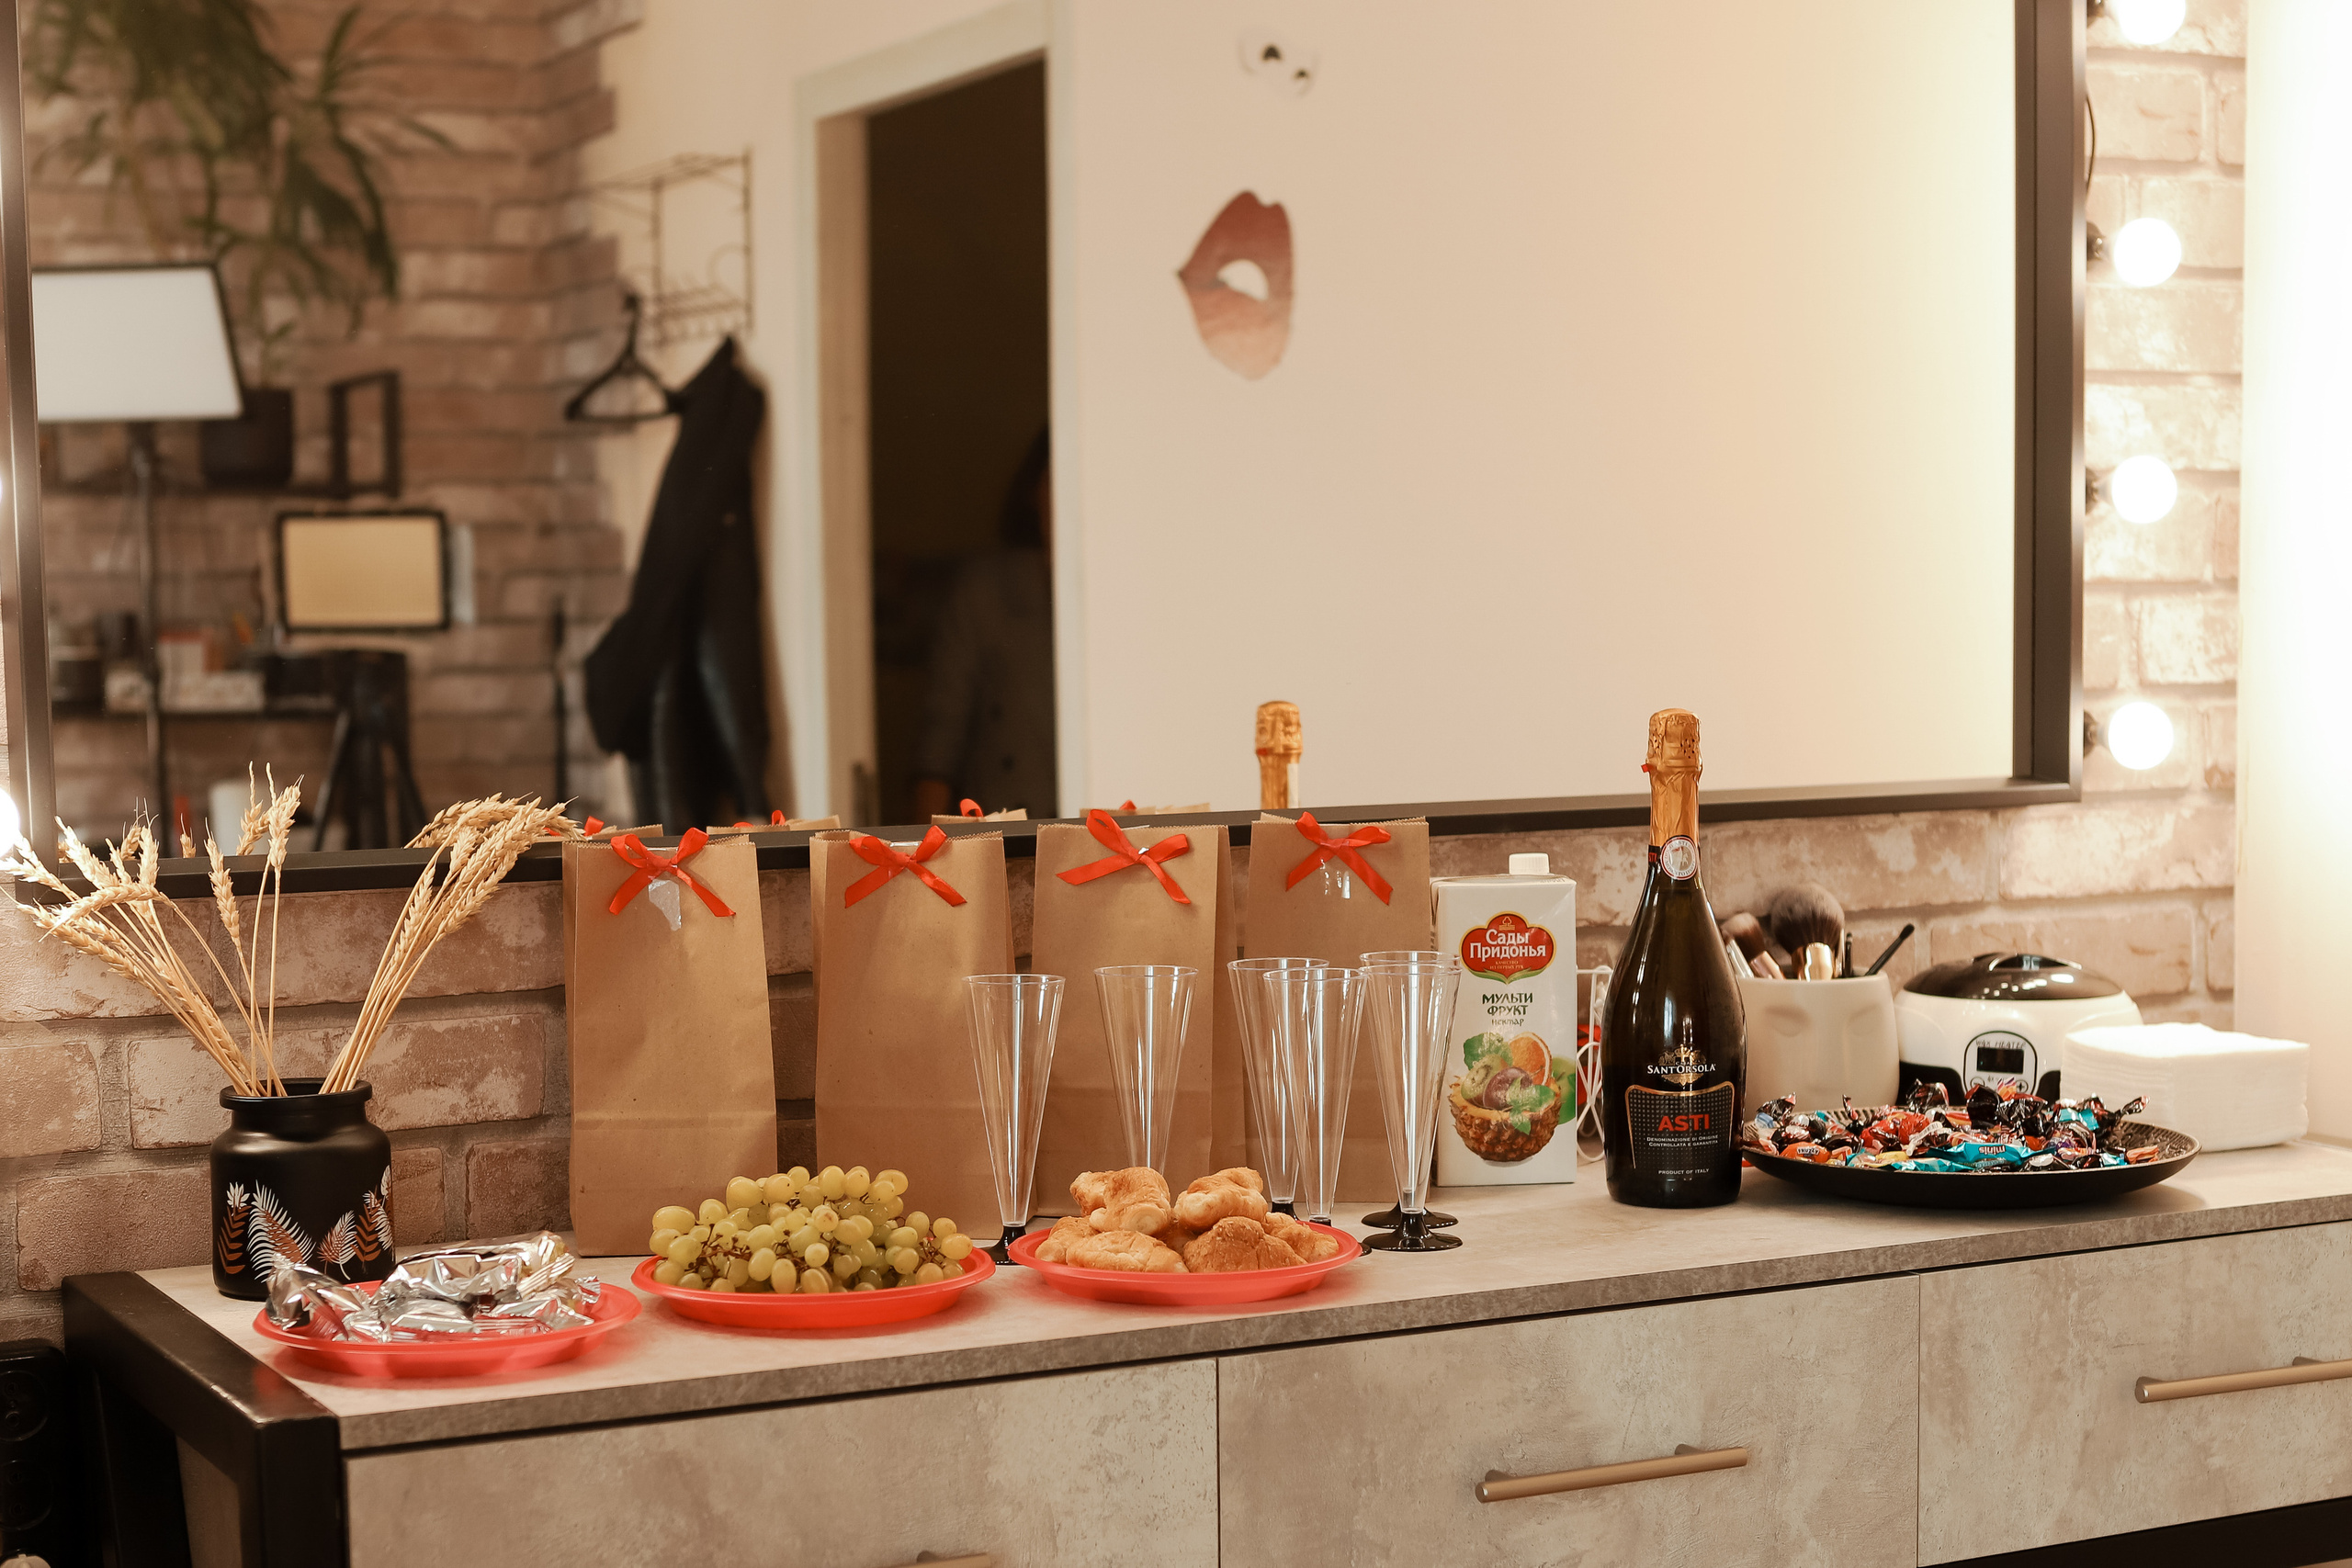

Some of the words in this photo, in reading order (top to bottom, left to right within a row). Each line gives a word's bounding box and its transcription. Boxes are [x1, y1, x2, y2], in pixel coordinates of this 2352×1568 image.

[1486, 929, 1530, 945] Сады
[1470, 942, 1546, 962] Придонья
[1482, 992, 1533, 1005] МУЛЬТИ
[1487, 1005, 1528, 1016] ФРУКТ
[1491, 1019, 1524, 1027] нектар
[1658, 1113, 1709, 1131] ASTI
[1979, 1145, 2006, 1155] minis
